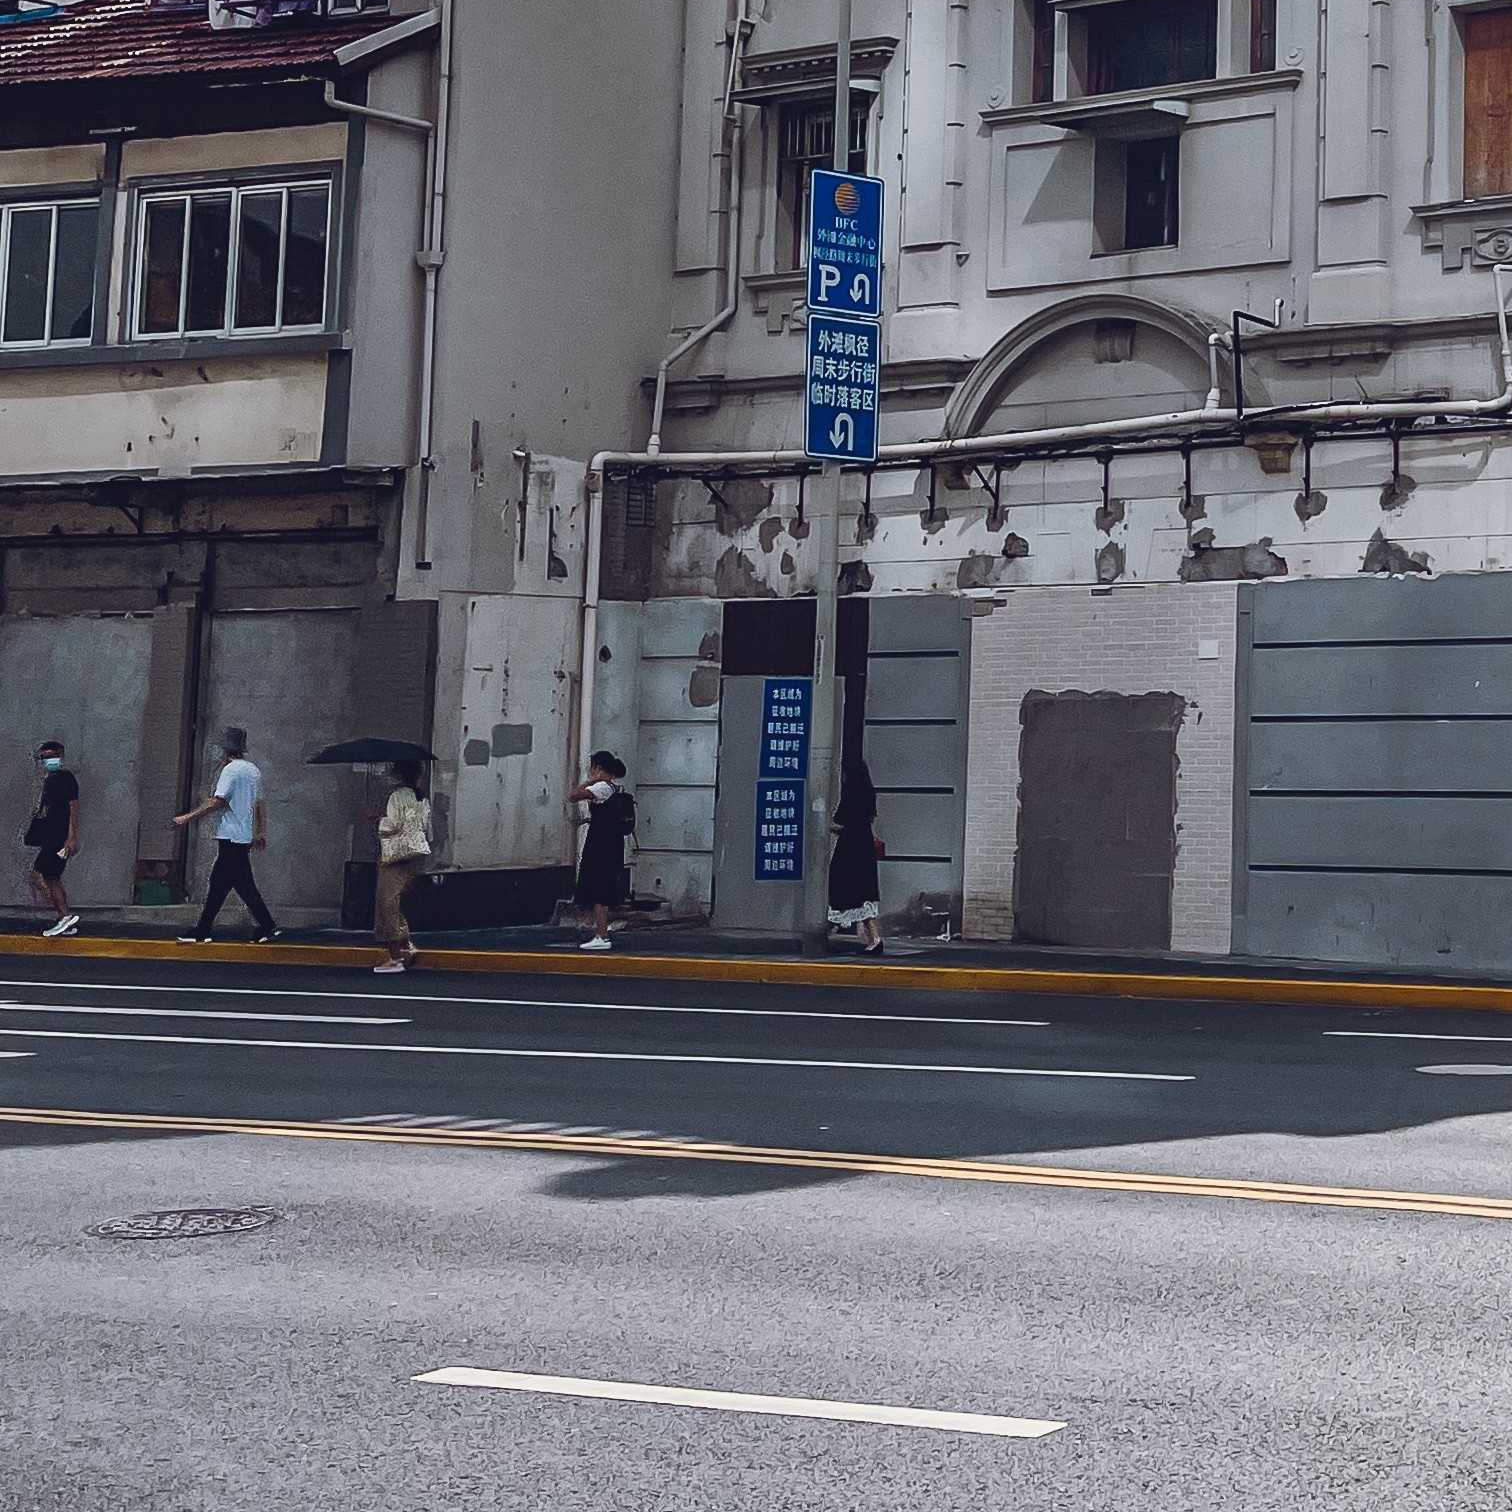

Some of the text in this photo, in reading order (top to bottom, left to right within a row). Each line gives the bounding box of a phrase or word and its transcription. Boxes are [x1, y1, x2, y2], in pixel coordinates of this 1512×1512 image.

[817, 263, 841, 302] P
[818, 329, 869, 357] 外滩枫径
[811, 355, 876, 385] 周末步行街
[811, 382, 874, 411] 临时落客区
